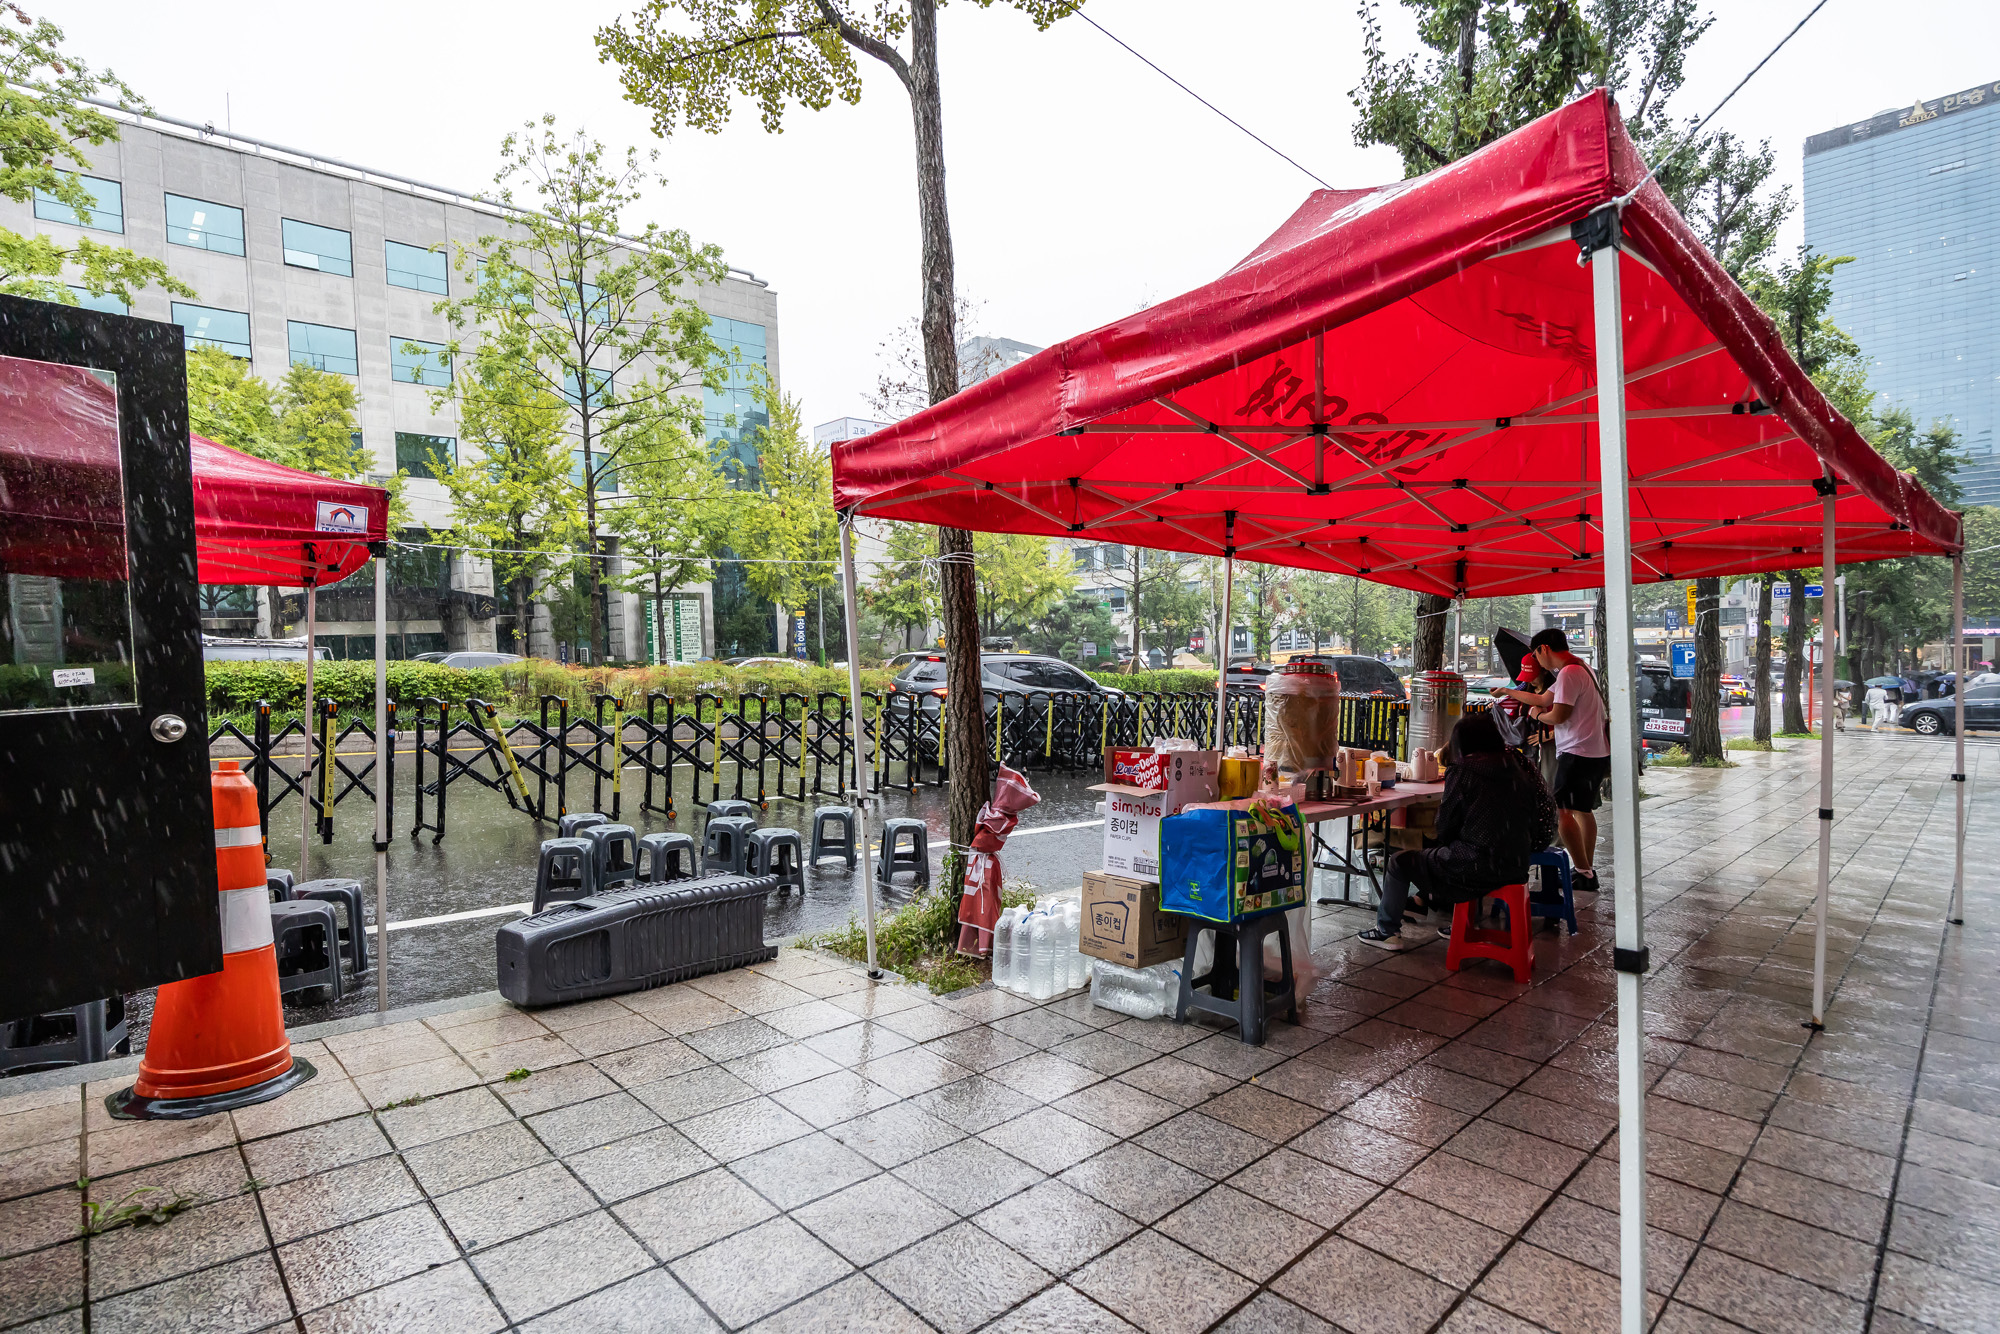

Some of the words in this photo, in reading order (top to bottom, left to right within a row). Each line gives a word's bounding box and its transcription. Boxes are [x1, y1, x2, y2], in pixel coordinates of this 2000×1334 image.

[1899, 110, 1938, 128] ASTRA
[1684, 650, 1696, 664] P
[1646, 723, 1684, 733] 신자유연대
[1139, 753, 1160, 770] Deep
[1135, 764, 1159, 784] choco
[1143, 774, 1162, 789] cake
[1111, 798, 1161, 817] simplus
[1110, 817, 1138, 835] 종이컵
[1095, 913, 1121, 931] 종이컵
